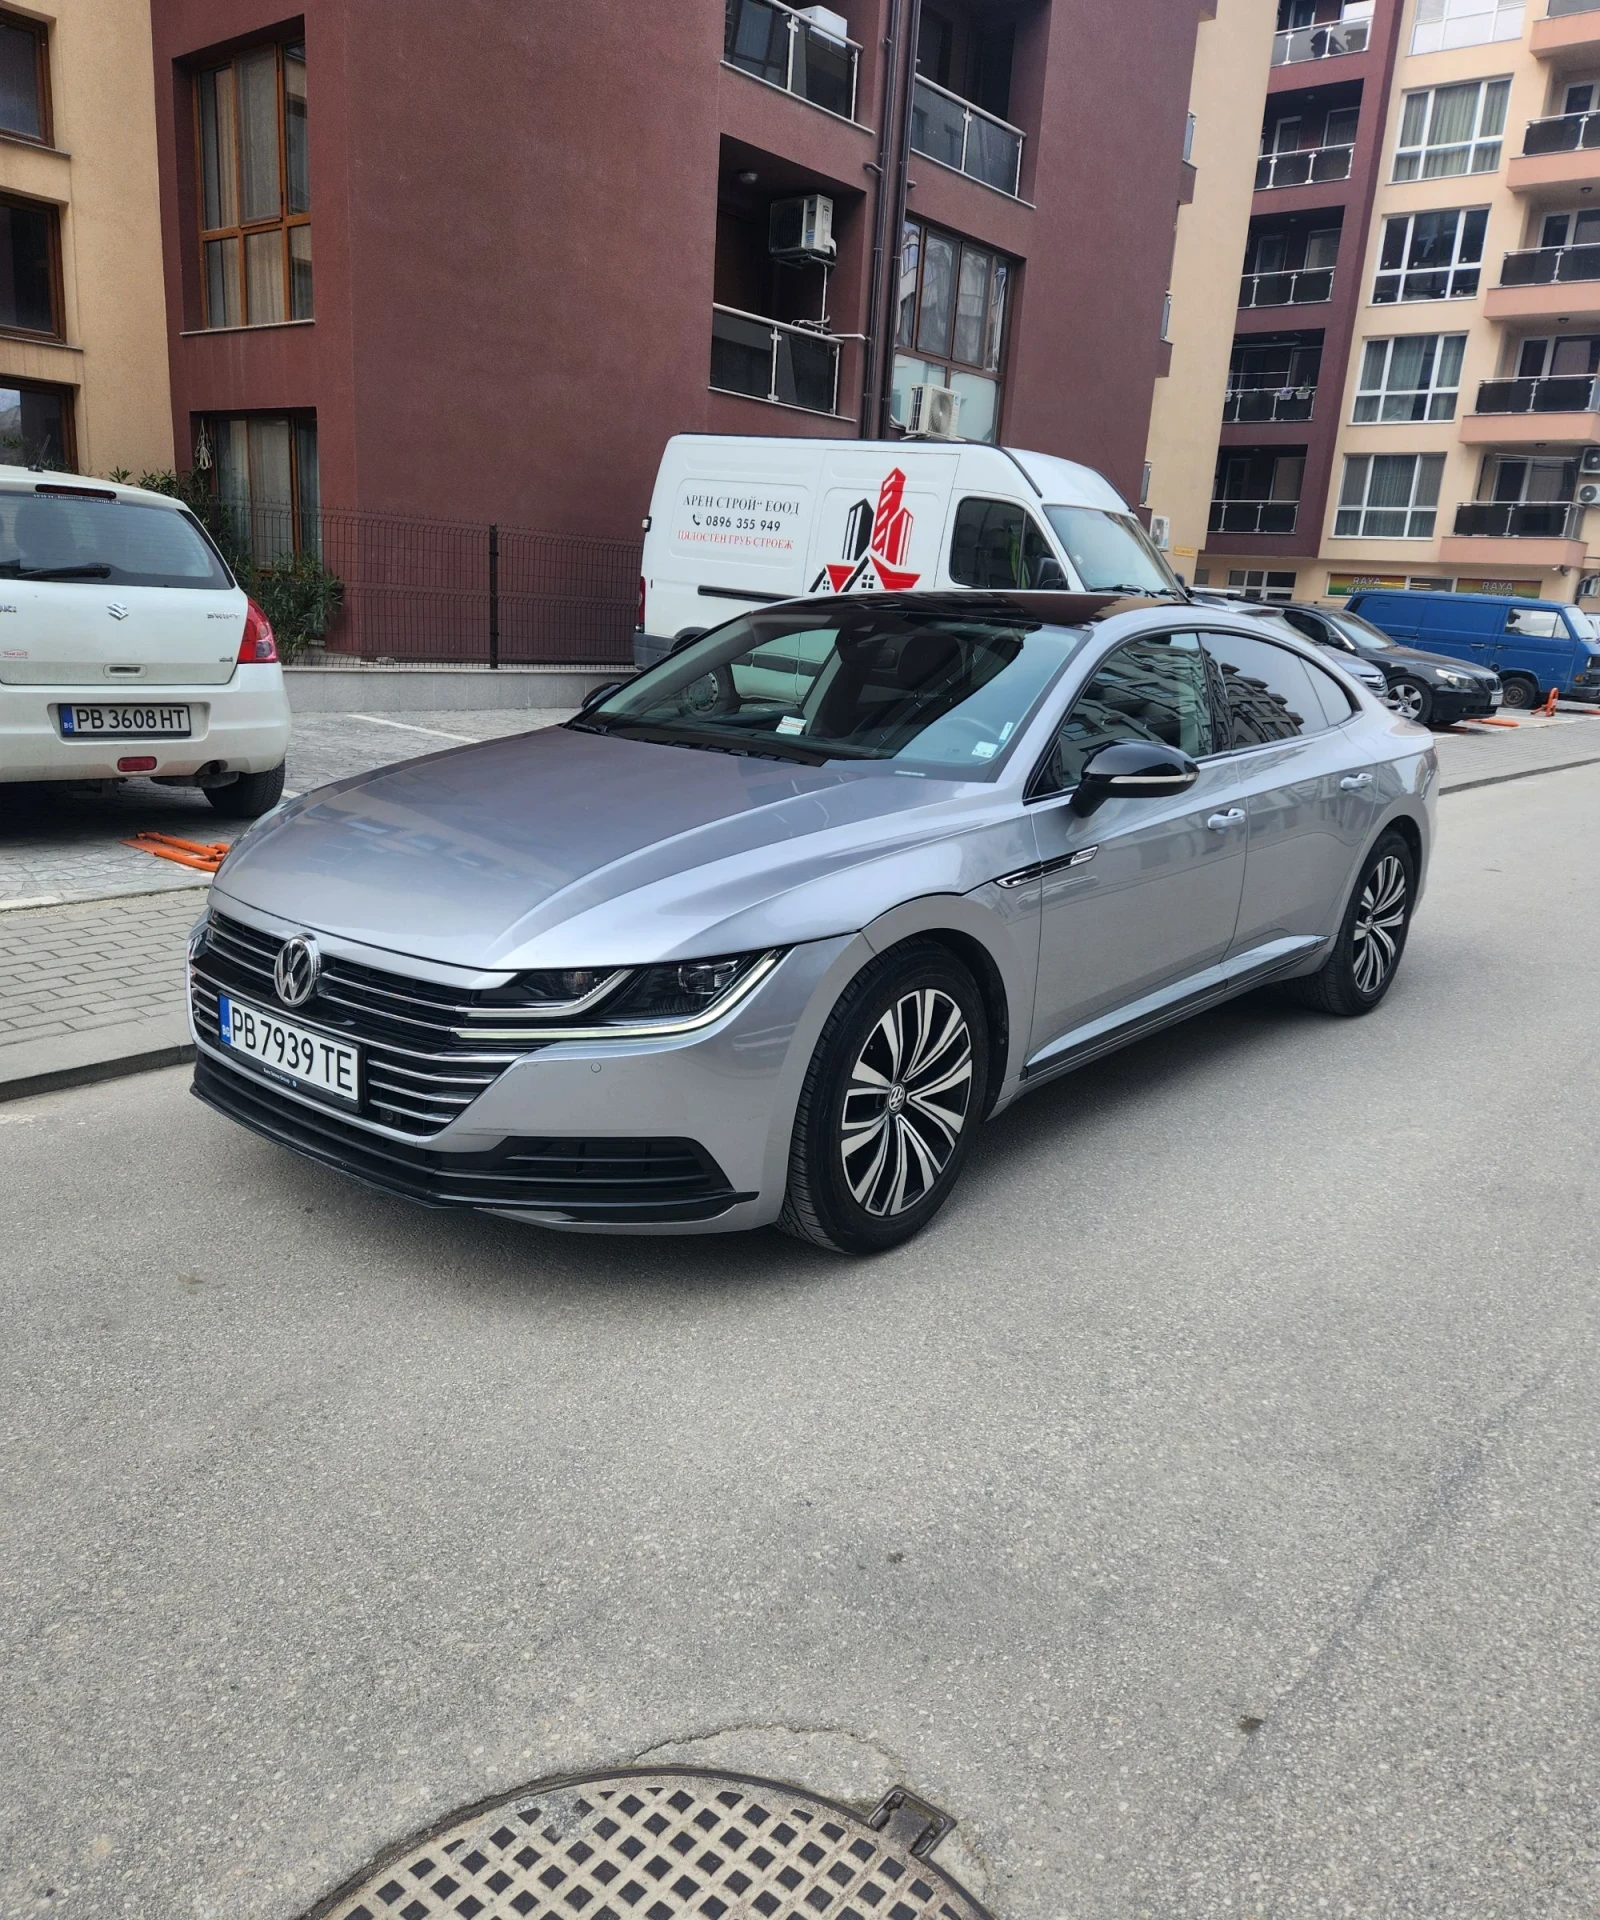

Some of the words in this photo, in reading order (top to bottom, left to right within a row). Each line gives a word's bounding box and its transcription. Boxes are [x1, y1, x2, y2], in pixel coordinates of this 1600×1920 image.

[683, 494, 713, 508] АРЕН
[765, 500, 800, 516] ЕООД
[706, 515, 732, 528] 0896
[736, 518, 756, 530] 355
[760, 520, 781, 532] 949
[677, 530, 727, 544] ЦЯЛОСТЕН
[728, 535, 751, 546] ГРУБ
[753, 537, 794, 550] СТРОЕЖ
[1352, 576, 1381, 586] RAYA
[1482, 581, 1513, 591] RAYA
[75, 708, 104, 730] PB
[108, 708, 157, 730] 3608
[160, 709, 185, 729] HT
[221, 1023, 231, 1038] BG
[231, 1006, 257, 1050] PB
[260, 1019, 314, 1075] 7939
[319, 1043, 353, 1092] TE
